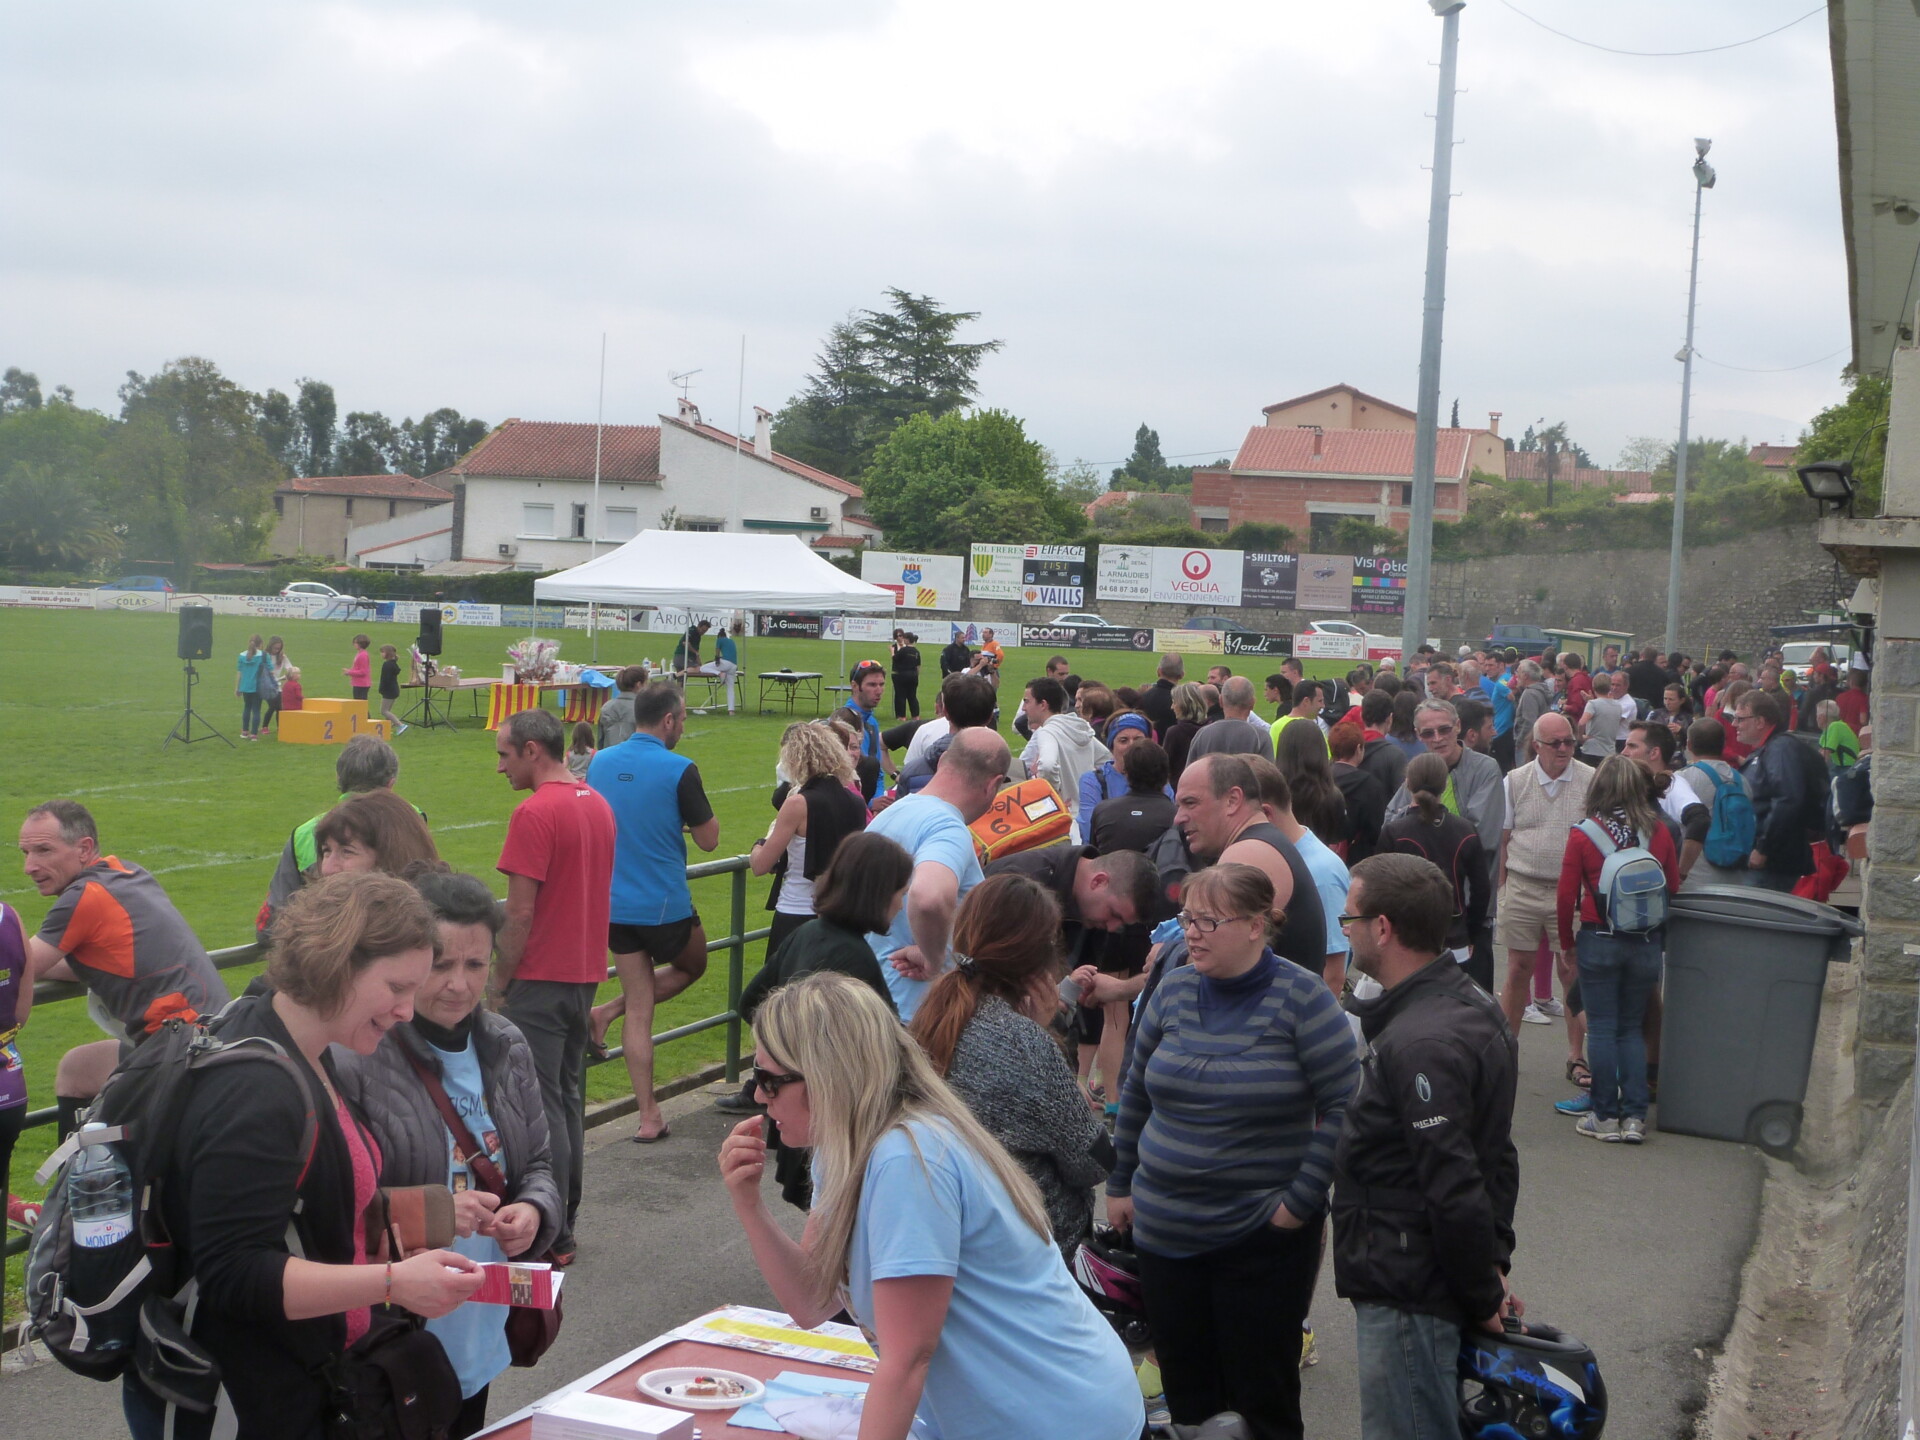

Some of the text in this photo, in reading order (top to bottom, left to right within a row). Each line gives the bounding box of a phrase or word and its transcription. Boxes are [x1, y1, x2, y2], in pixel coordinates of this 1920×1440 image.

[992, 546, 1024, 554] FRERES
[1041, 545, 1084, 556] EIFFAGE
[1252, 554, 1290, 563] SHILTON
[1107, 571, 1149, 579] ARNAUDIES
[1171, 581, 1219, 593] VEOLIA
[239, 595, 302, 603] CARDOSO
[1040, 587, 1081, 605] VAILLS
[1154, 592, 1236, 603] ENVIRONNEMENT
[117, 598, 147, 606] COLAS
[598, 610, 616, 618] Volets
[768, 617, 819, 629] LA GUINGUETTE
[1022, 626, 1076, 641] ECOCUP
[1232, 635, 1269, 654] Jordi
[351, 714, 356, 733] 1
[324, 720, 333, 739] 2
[1412, 1116, 1448, 1128] RICHA
